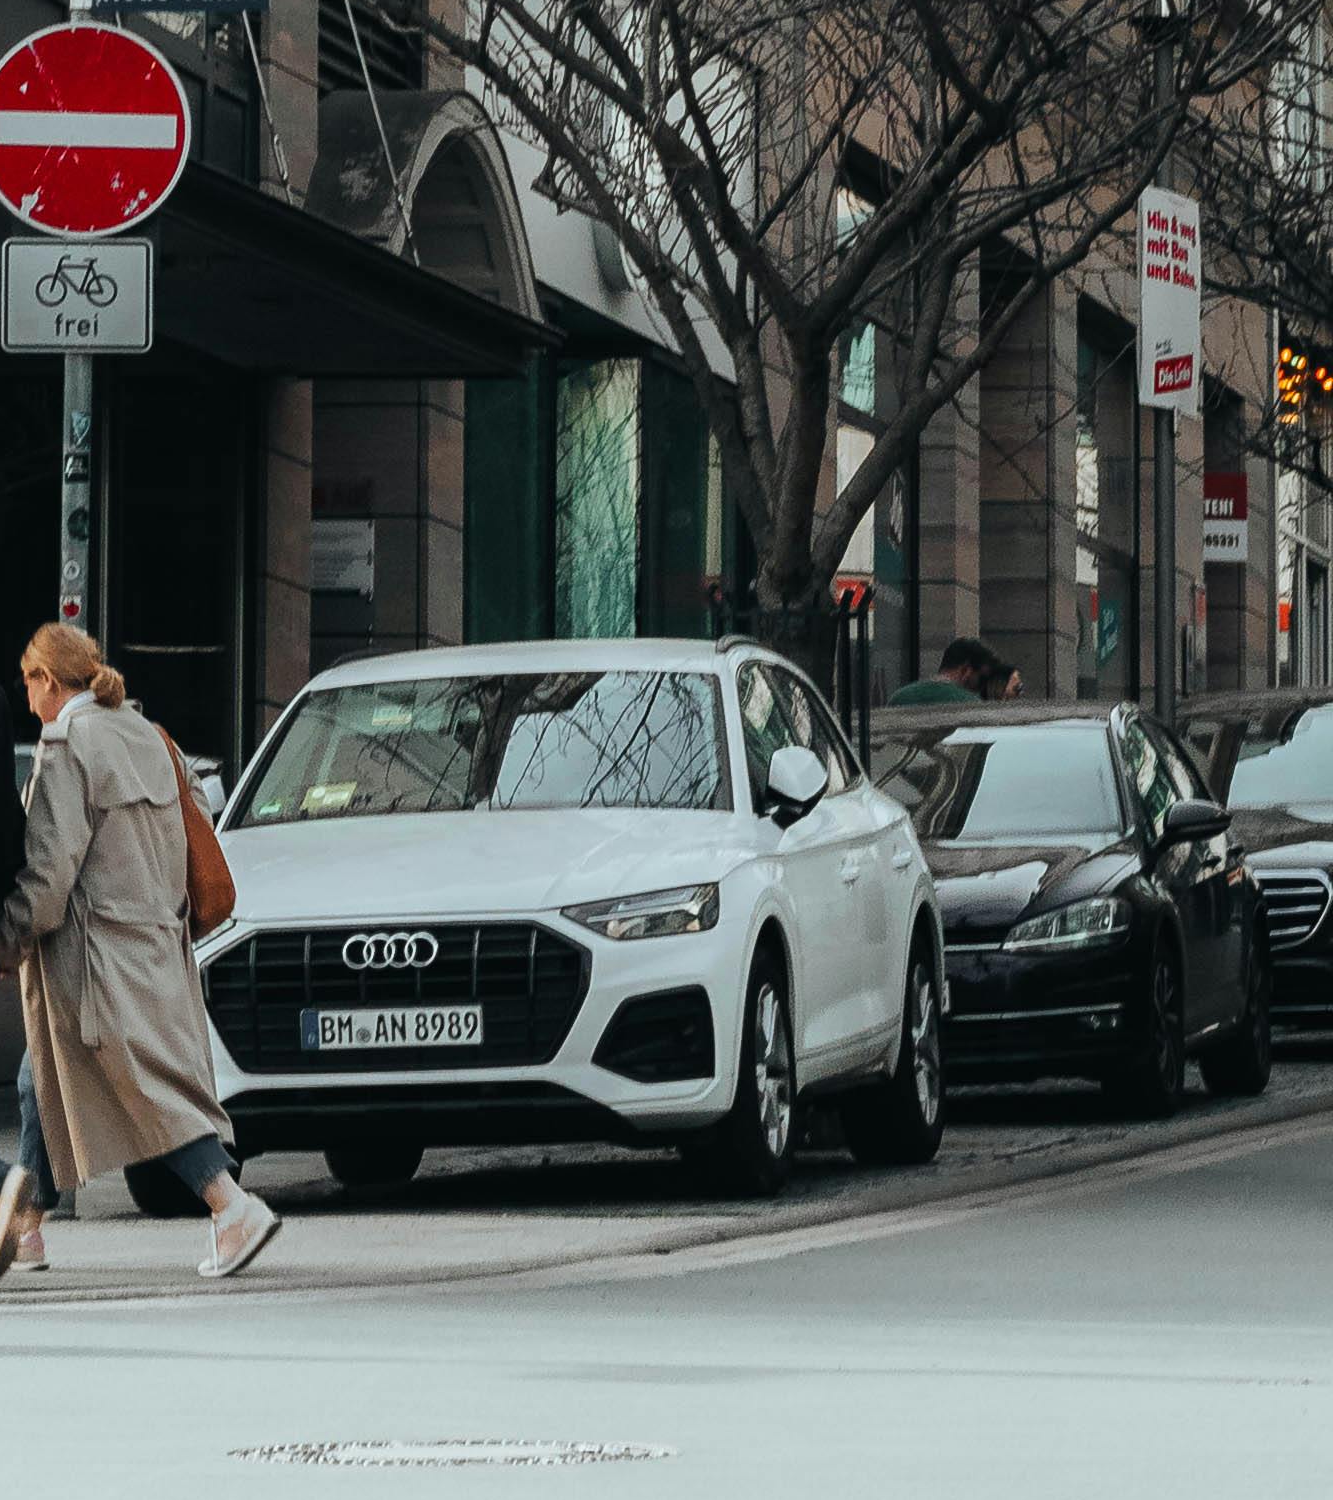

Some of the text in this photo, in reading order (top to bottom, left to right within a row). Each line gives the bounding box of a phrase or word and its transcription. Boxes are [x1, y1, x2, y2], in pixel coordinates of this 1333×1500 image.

[1146, 261, 1170, 283] und
[55, 312, 99, 338] frei
[320, 1016, 353, 1045] BM
[374, 1013, 407, 1043] AN
[414, 1011, 479, 1042] 8989
